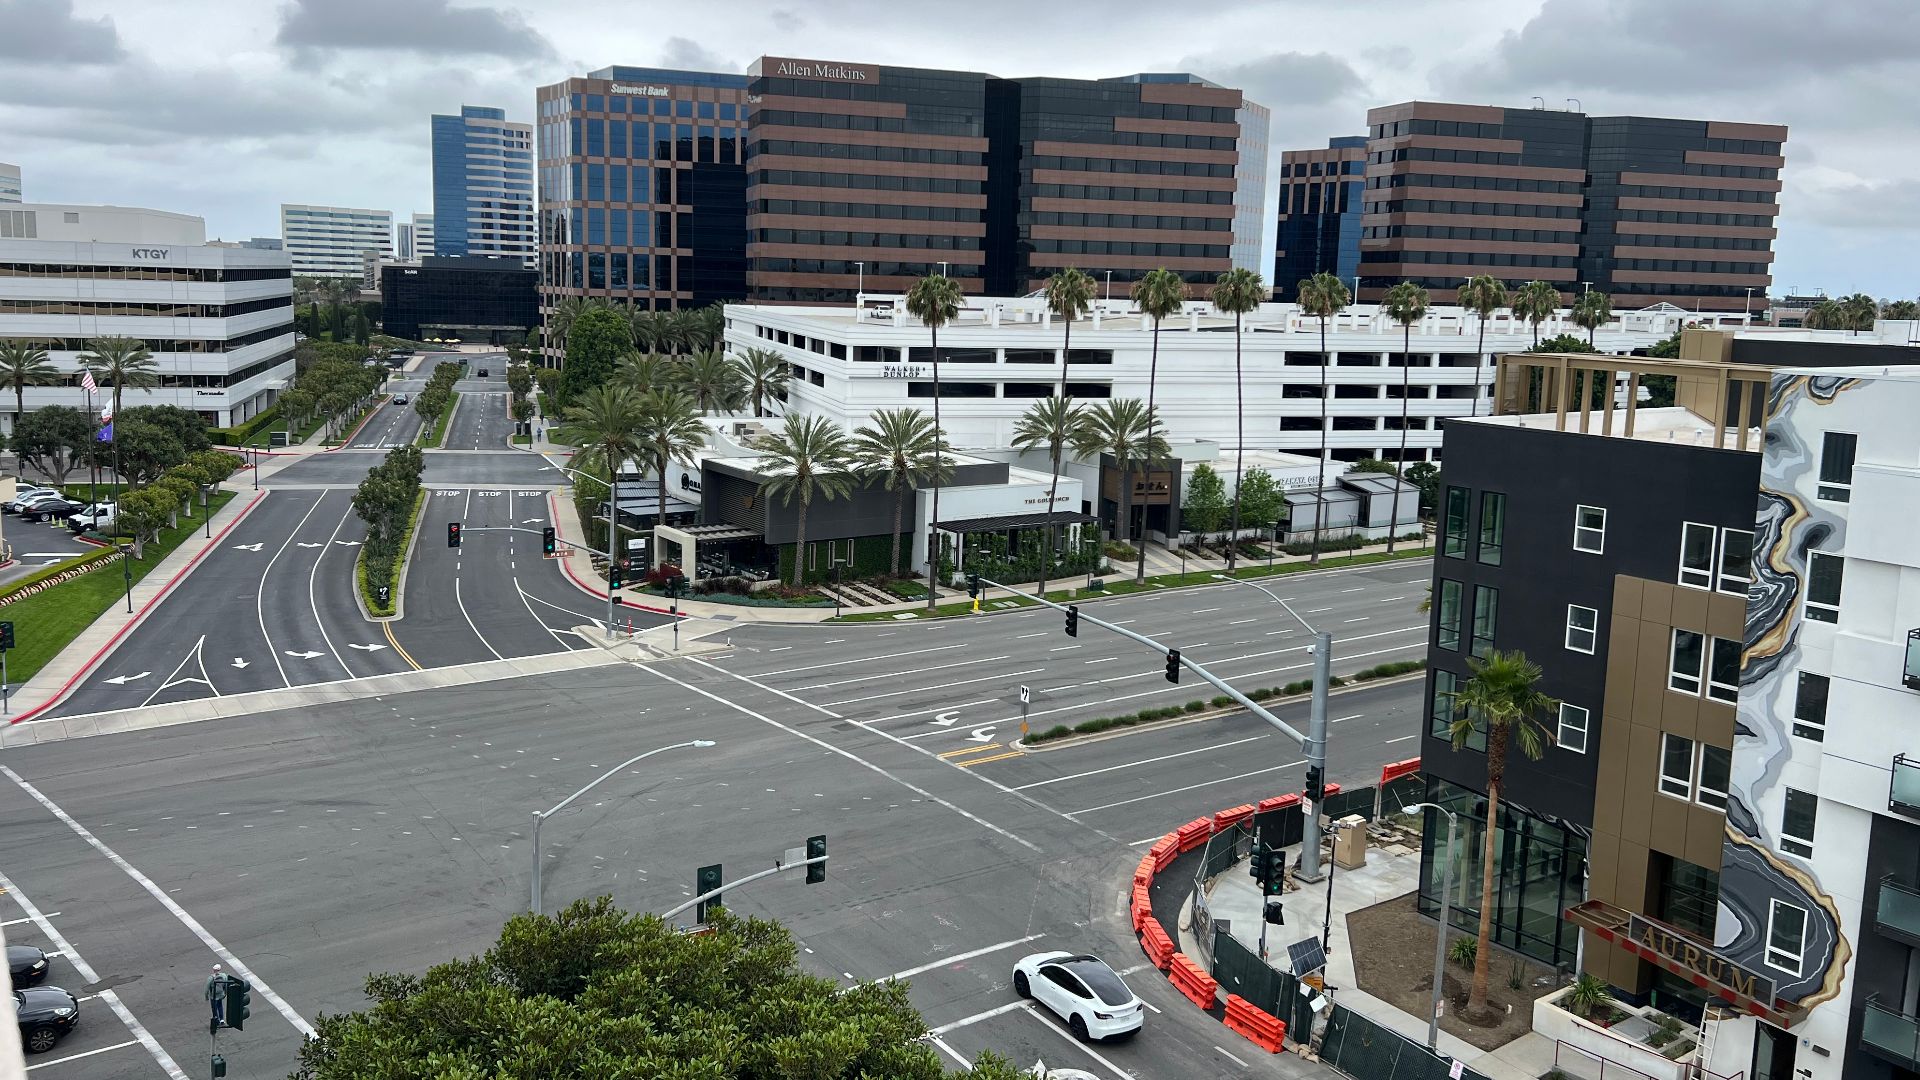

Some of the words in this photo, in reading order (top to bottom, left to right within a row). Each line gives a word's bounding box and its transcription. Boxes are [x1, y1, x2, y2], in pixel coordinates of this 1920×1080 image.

[777, 62, 811, 77] Allen
[815, 64, 866, 80] Matkins
[610, 83, 647, 95] Sunwest
[647, 86, 669, 97] Bank
[132, 248, 169, 259] KTGY
[1641, 926, 1757, 1000] AURUM
